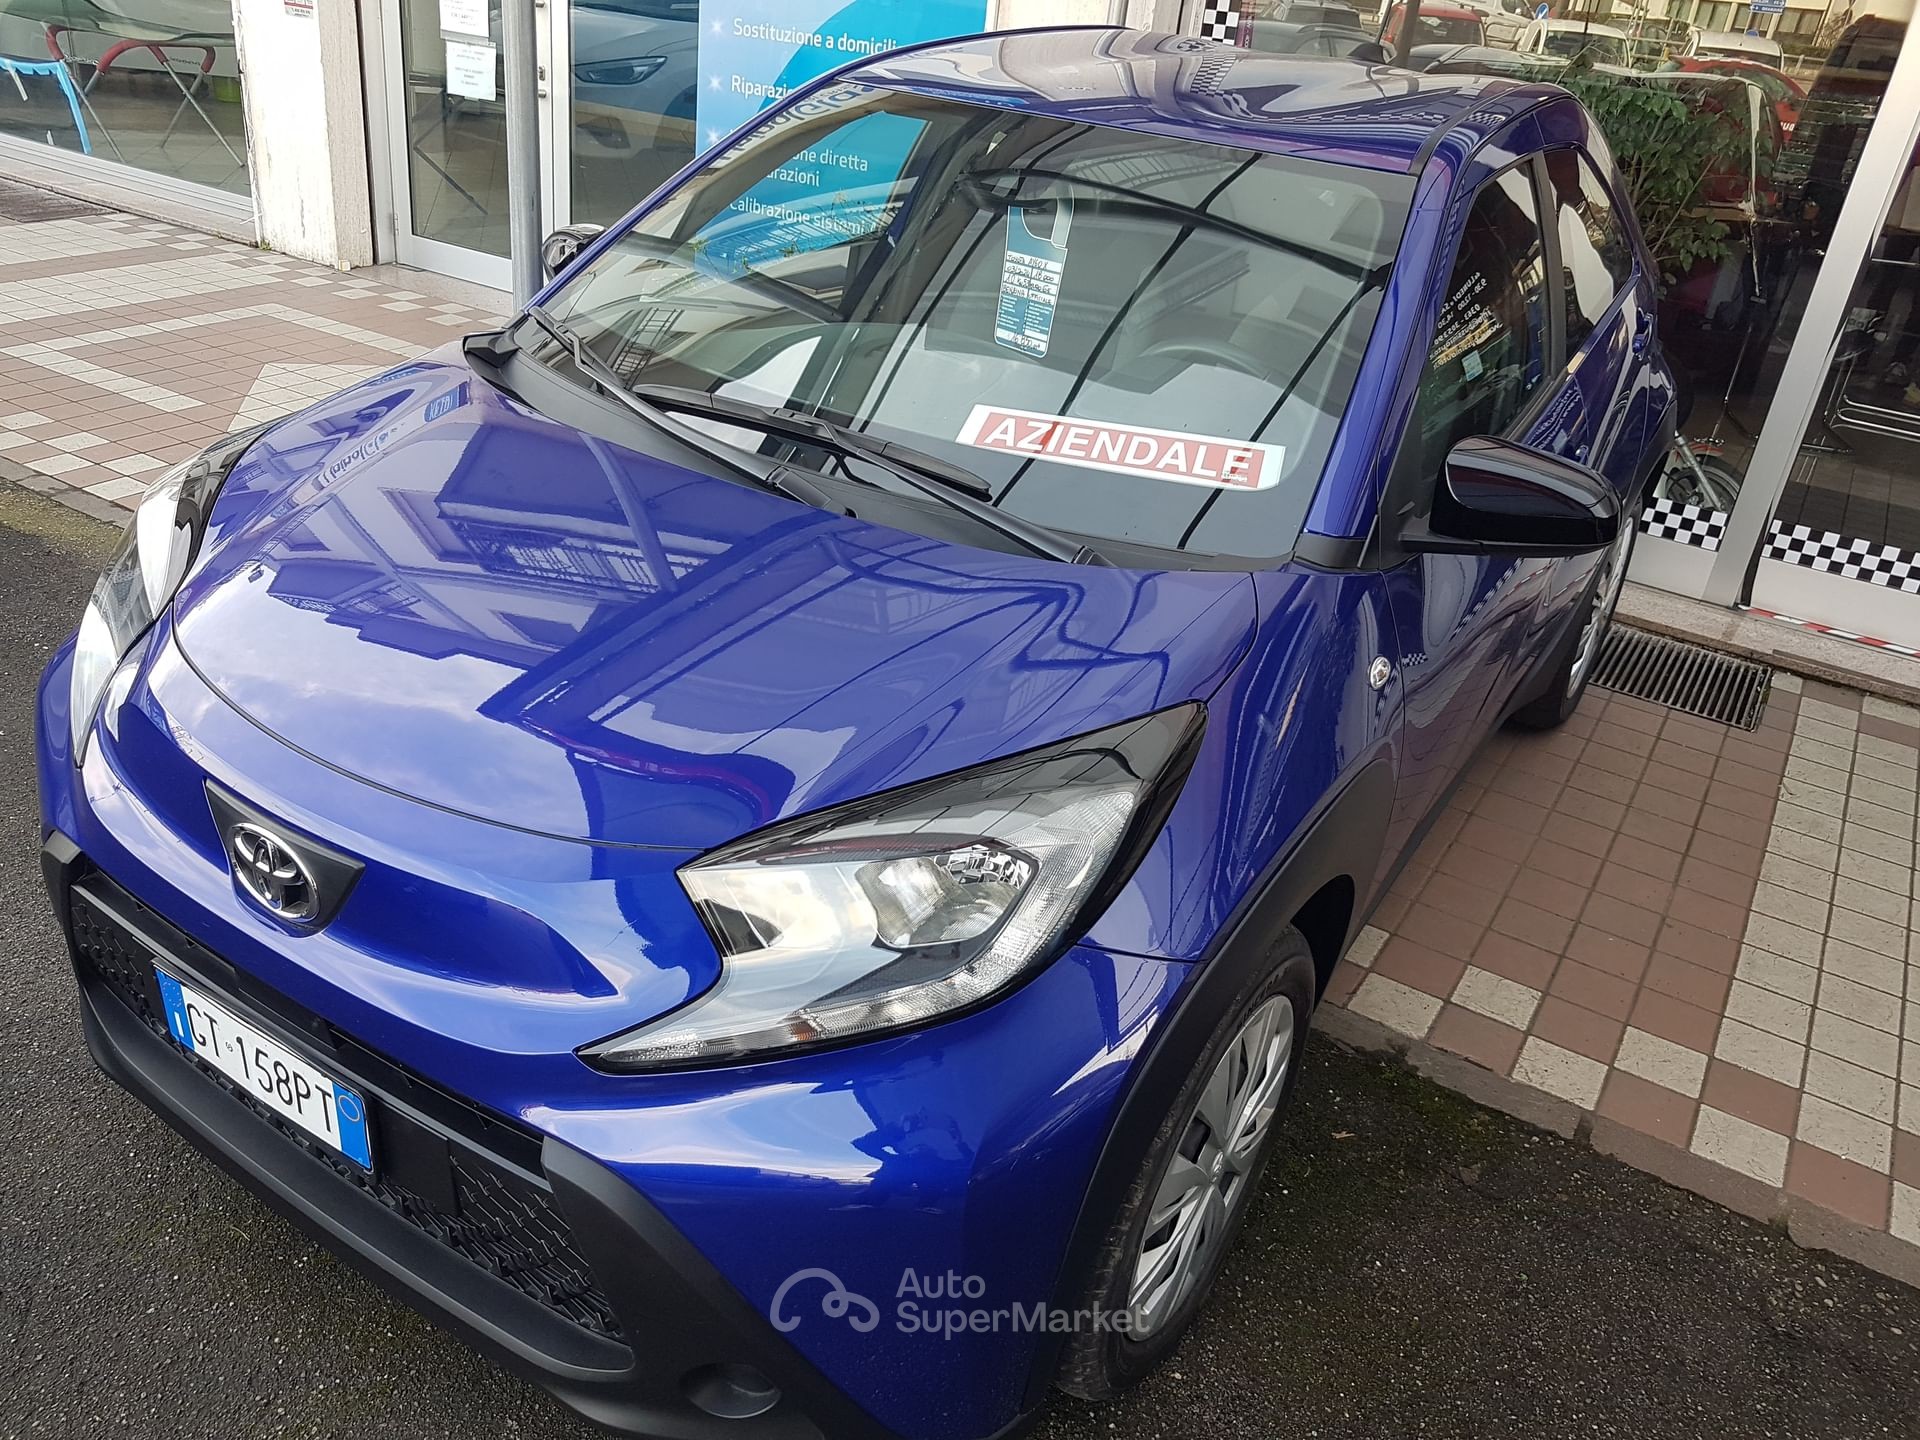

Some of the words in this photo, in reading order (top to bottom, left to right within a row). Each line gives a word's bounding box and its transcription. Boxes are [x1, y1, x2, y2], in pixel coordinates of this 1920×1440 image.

[733, 18, 821, 48] Sostituzione
[825, 37, 835, 50] a
[837, 33, 897, 55] domicili
[731, 75, 792, 99] Riparazi
[820, 148, 868, 172] diretta
[814, 213, 865, 235] sistemi
[984, 417, 1253, 481] AZIENDALE
[186, 1002, 220, 1058] GT
[235, 1036, 332, 1133] 158PT
